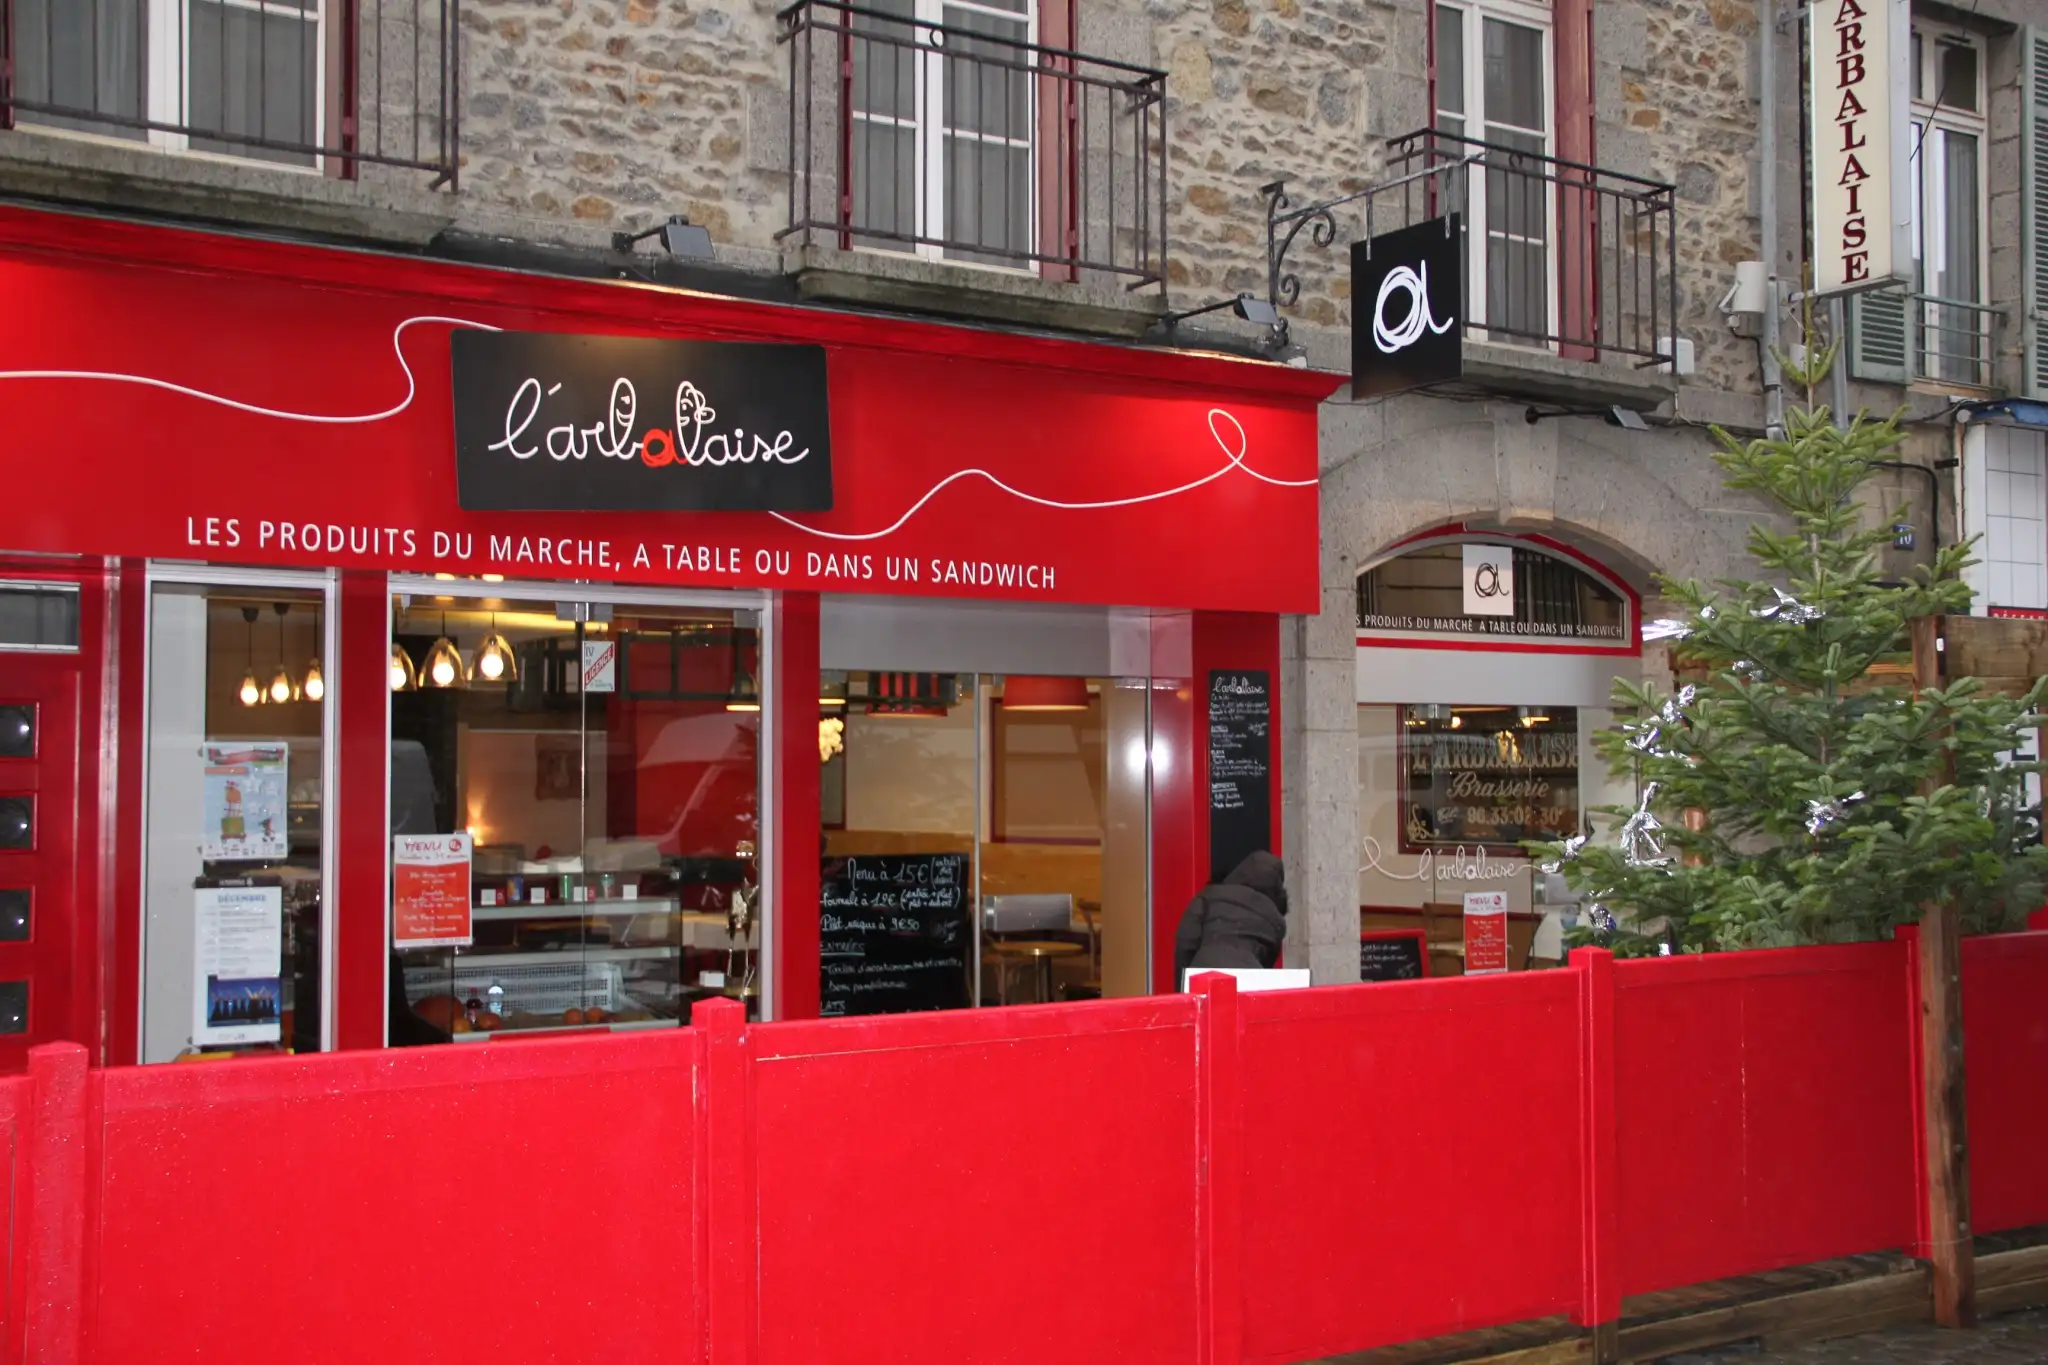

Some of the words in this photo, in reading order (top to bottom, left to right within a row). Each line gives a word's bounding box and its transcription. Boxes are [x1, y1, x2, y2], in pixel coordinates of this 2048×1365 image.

[1833, 0, 1870, 284] ARBALAISE
[187, 516, 241, 548] LES
[259, 520, 417, 557] PRODUITS
[433, 530, 473, 560] DU
[489, 534, 621, 572] MARCHE,
[632, 542, 651, 570] A
[662, 543, 741, 574] TABLE
[754, 549, 790, 577] OU
[807, 551, 873, 579] DANS
[885, 556, 919, 581] UN
[931, 559, 1056, 589] SANDWICH
[1364, 614, 1413, 629] PRODUITS
[1416, 617, 1430, 630] DU
[1479, 620, 1487, 632] A
[1533, 622, 1557, 635] DANS
[1560, 623, 1573, 635] UN
[1576, 624, 1623, 638] SANDWICH
[585, 646, 613, 686] LICENCE
[1446, 771, 1549, 798] Brasserie
